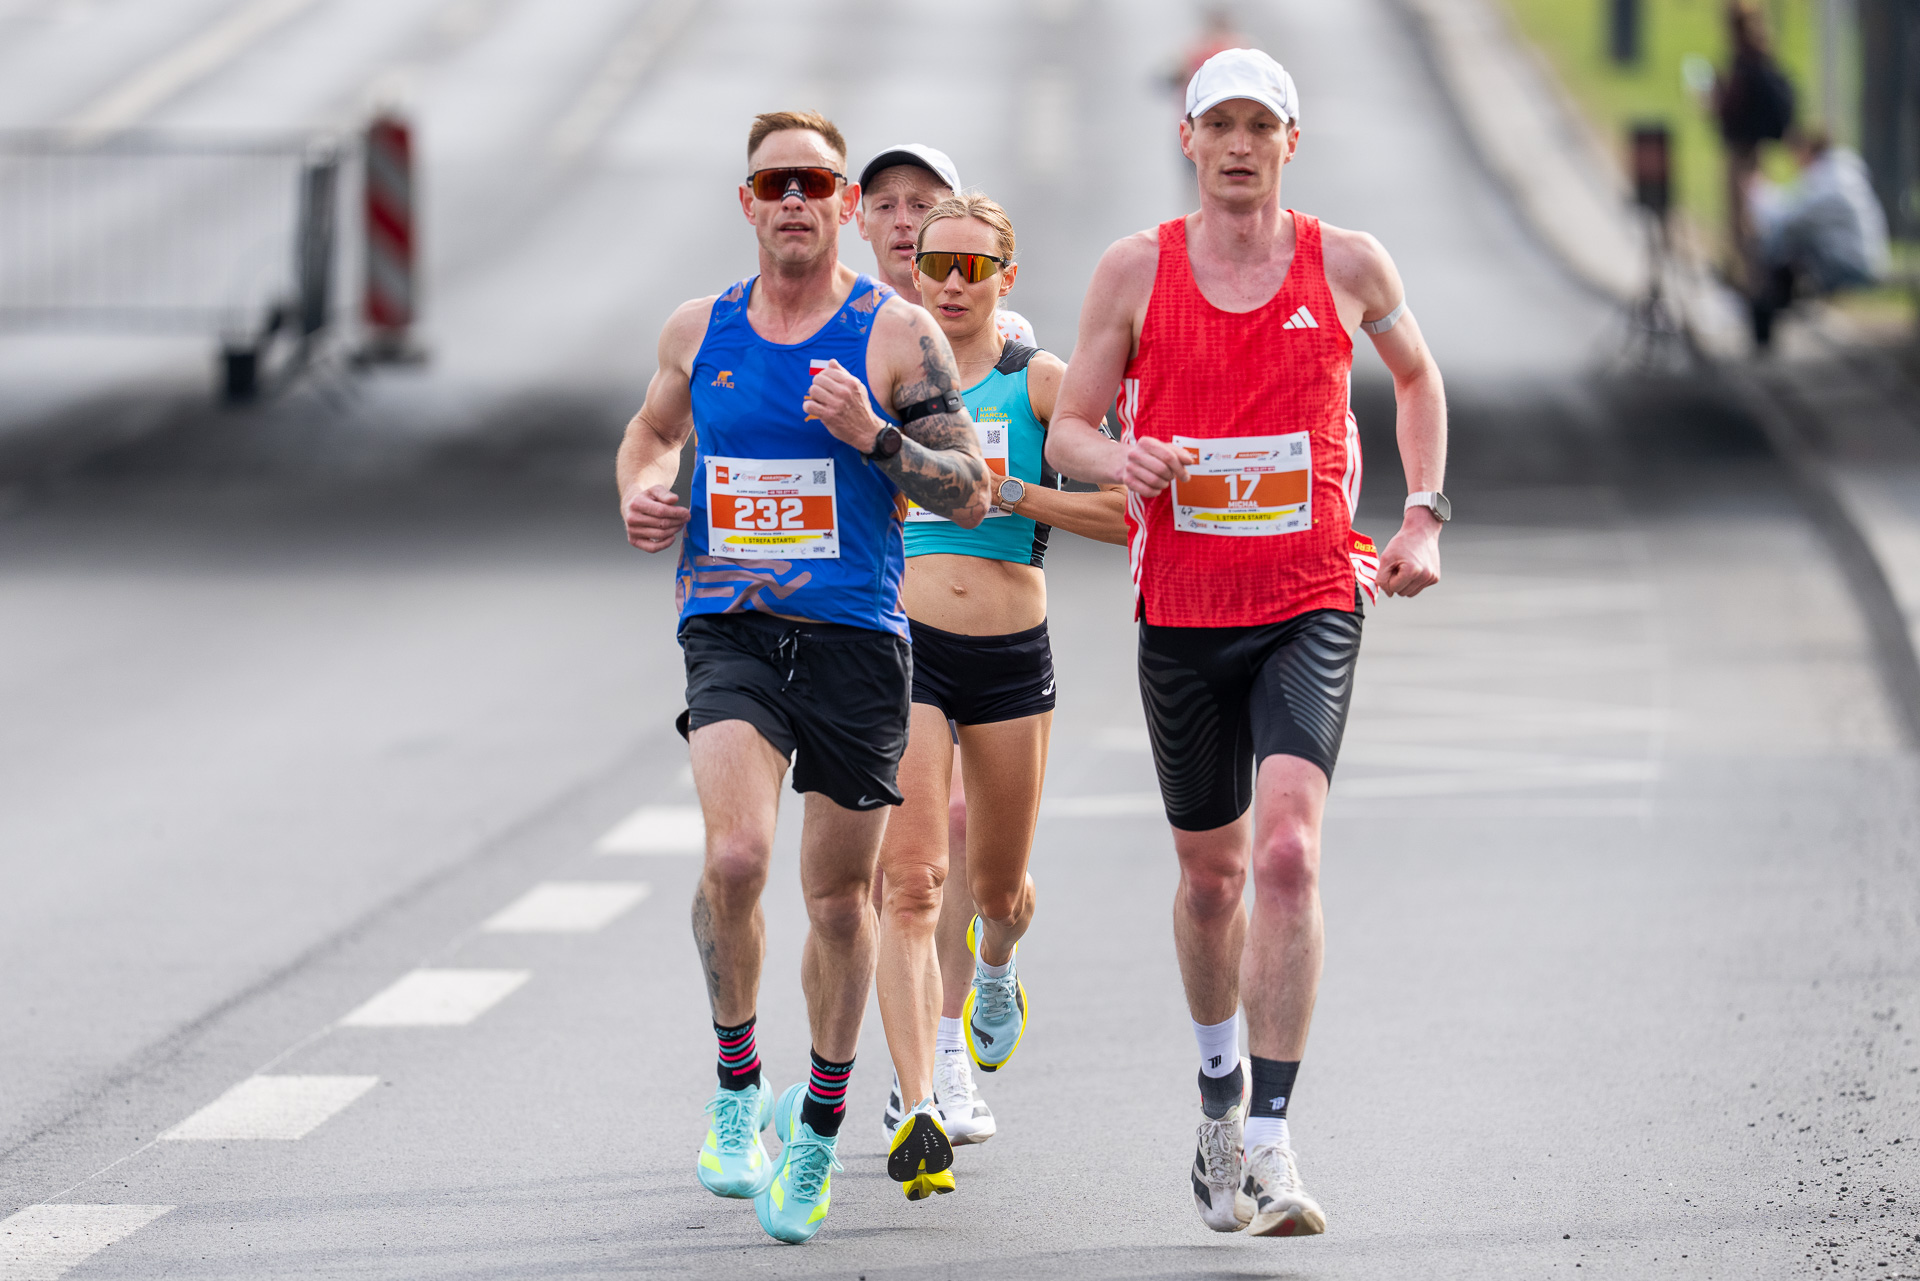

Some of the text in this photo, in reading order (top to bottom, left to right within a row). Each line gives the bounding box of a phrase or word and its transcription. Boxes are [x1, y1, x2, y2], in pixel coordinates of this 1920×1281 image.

[1225, 474, 1261, 500] 17
[734, 497, 805, 530] 232
[729, 1025, 749, 1037] cep
